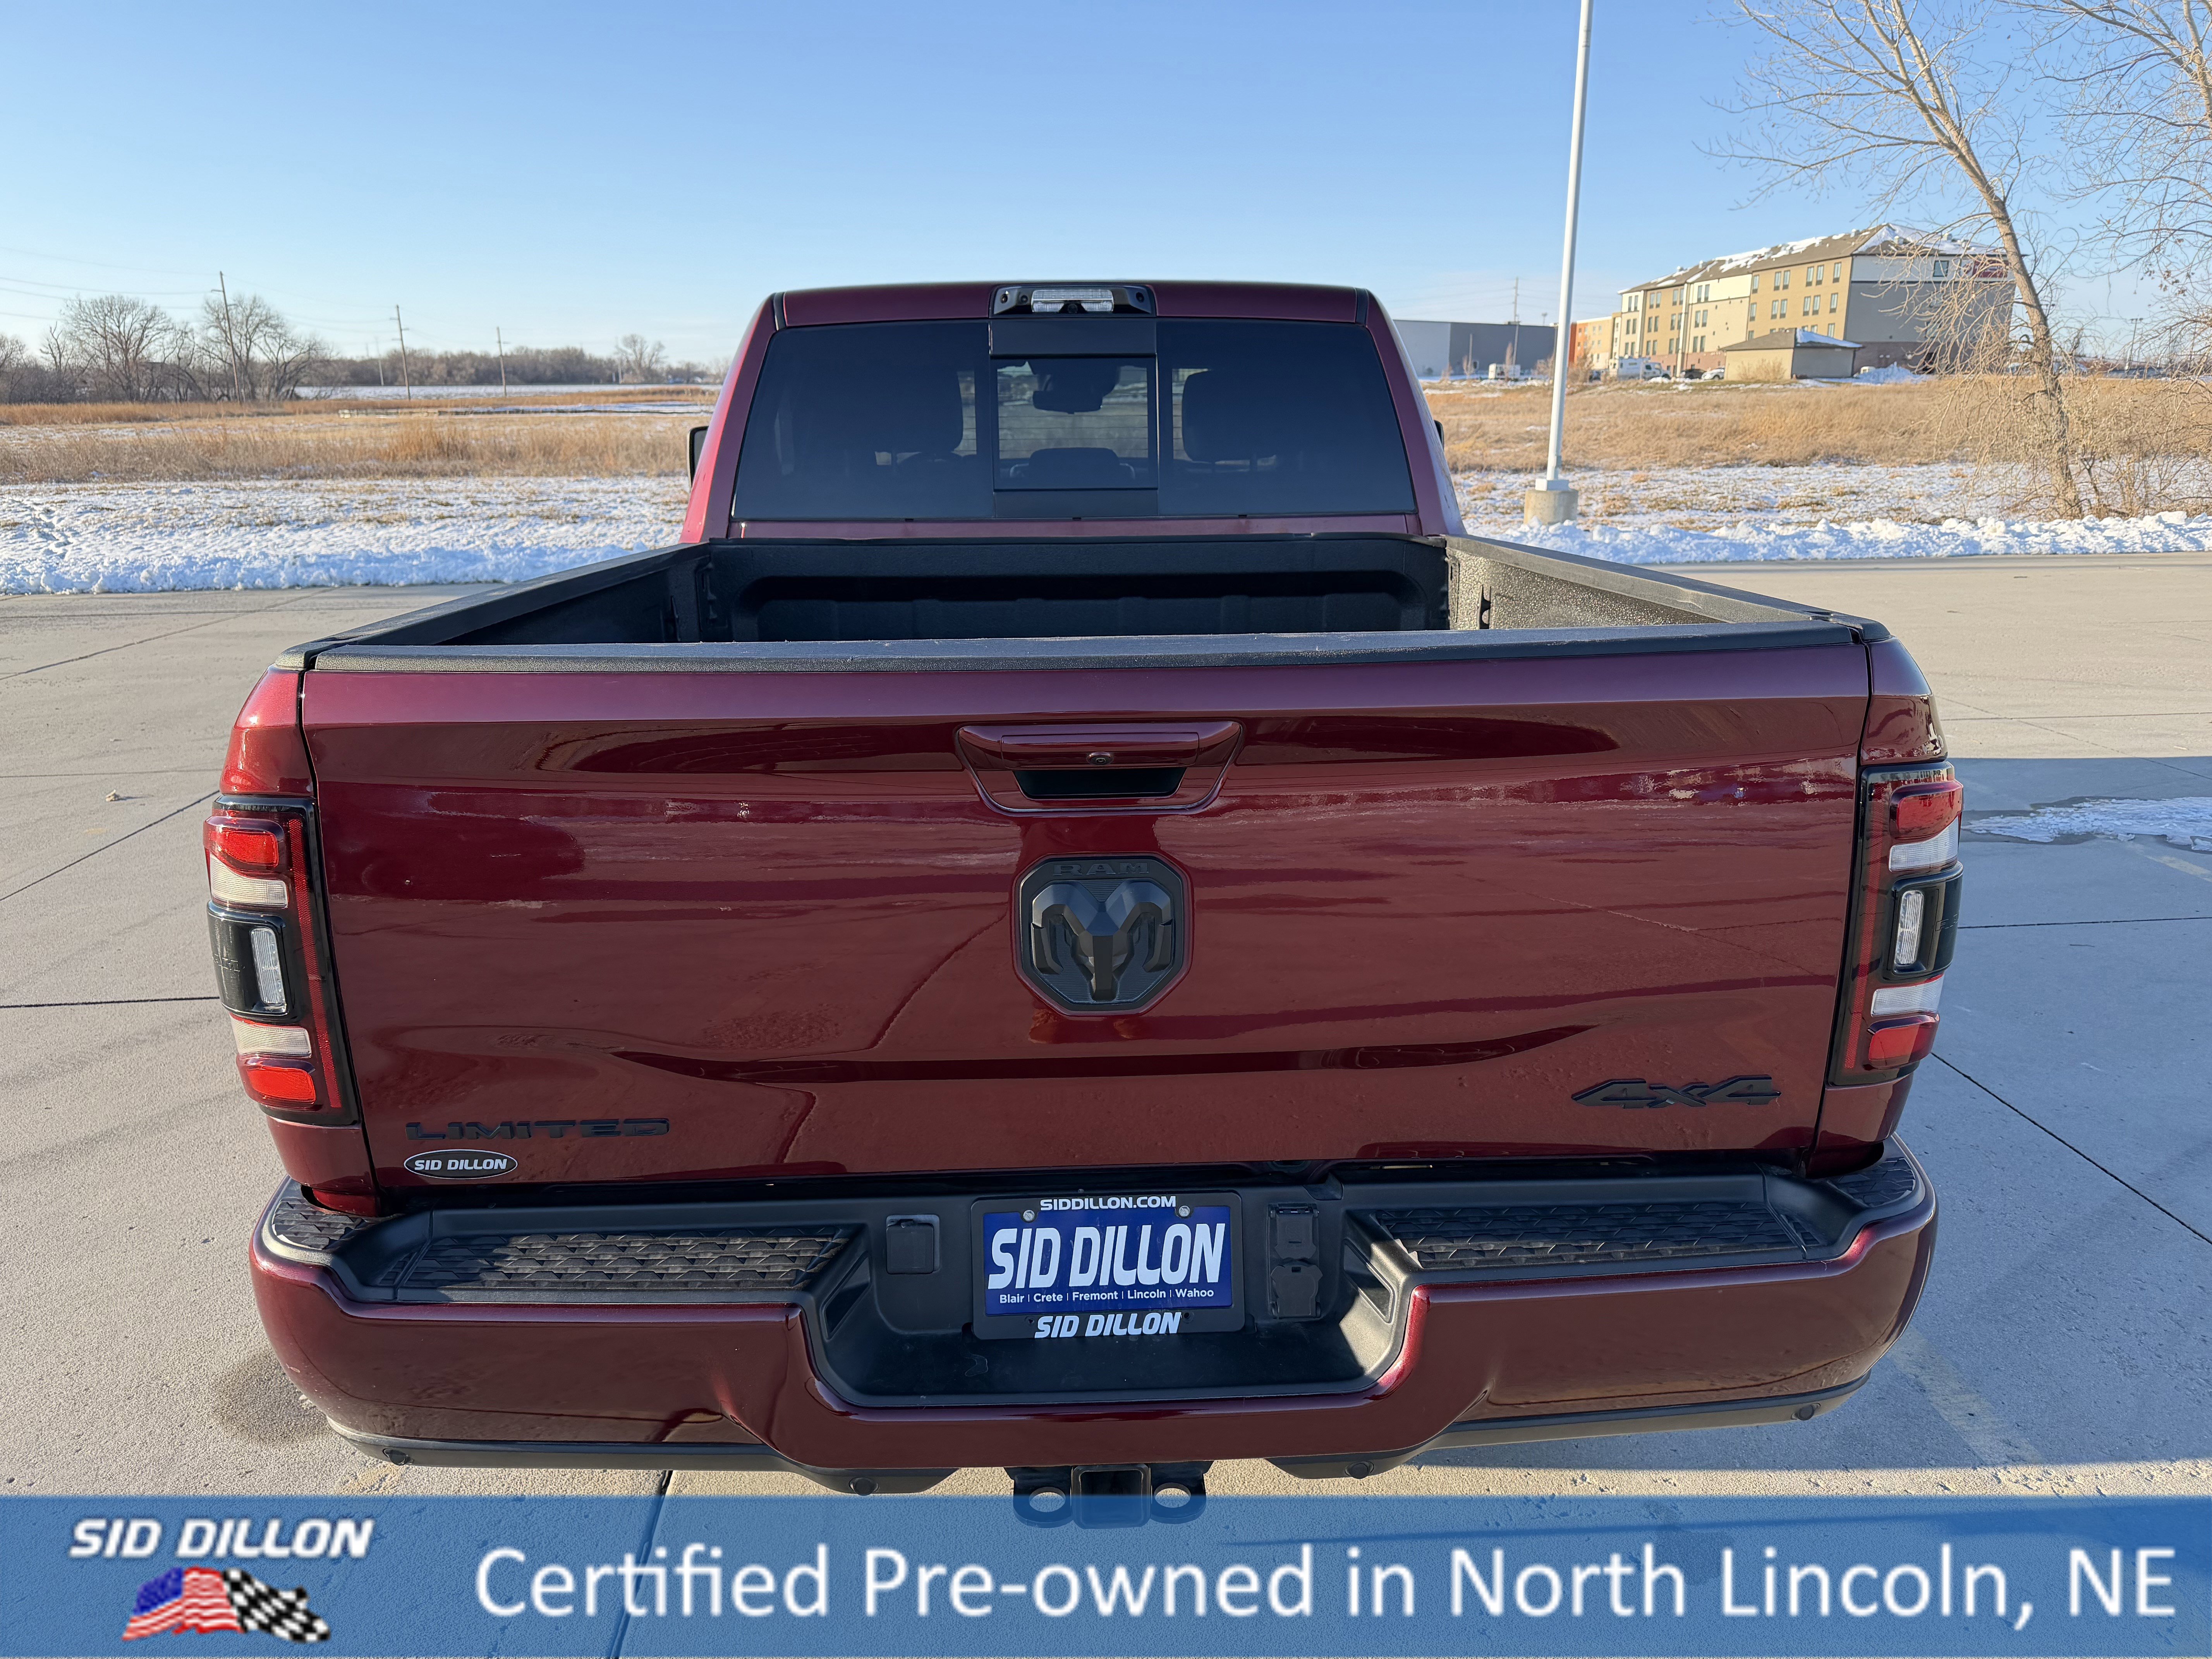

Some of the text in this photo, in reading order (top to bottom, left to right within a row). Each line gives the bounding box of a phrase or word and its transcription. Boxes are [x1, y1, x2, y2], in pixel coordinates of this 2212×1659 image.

[1052, 862, 1149, 876] RAM
[405, 1118, 670, 1140] LIMITED
[414, 1159, 507, 1170] SID DILLON
[1040, 1195, 1176, 1211] SIDDILLON.COM
[988, 1223, 1225, 1290] SID DILLON
[1000, 1288, 1214, 1304] Blair Crete Fremont Lincoln Wahoo
[1034, 1311, 1182, 1339] SID DILLON
